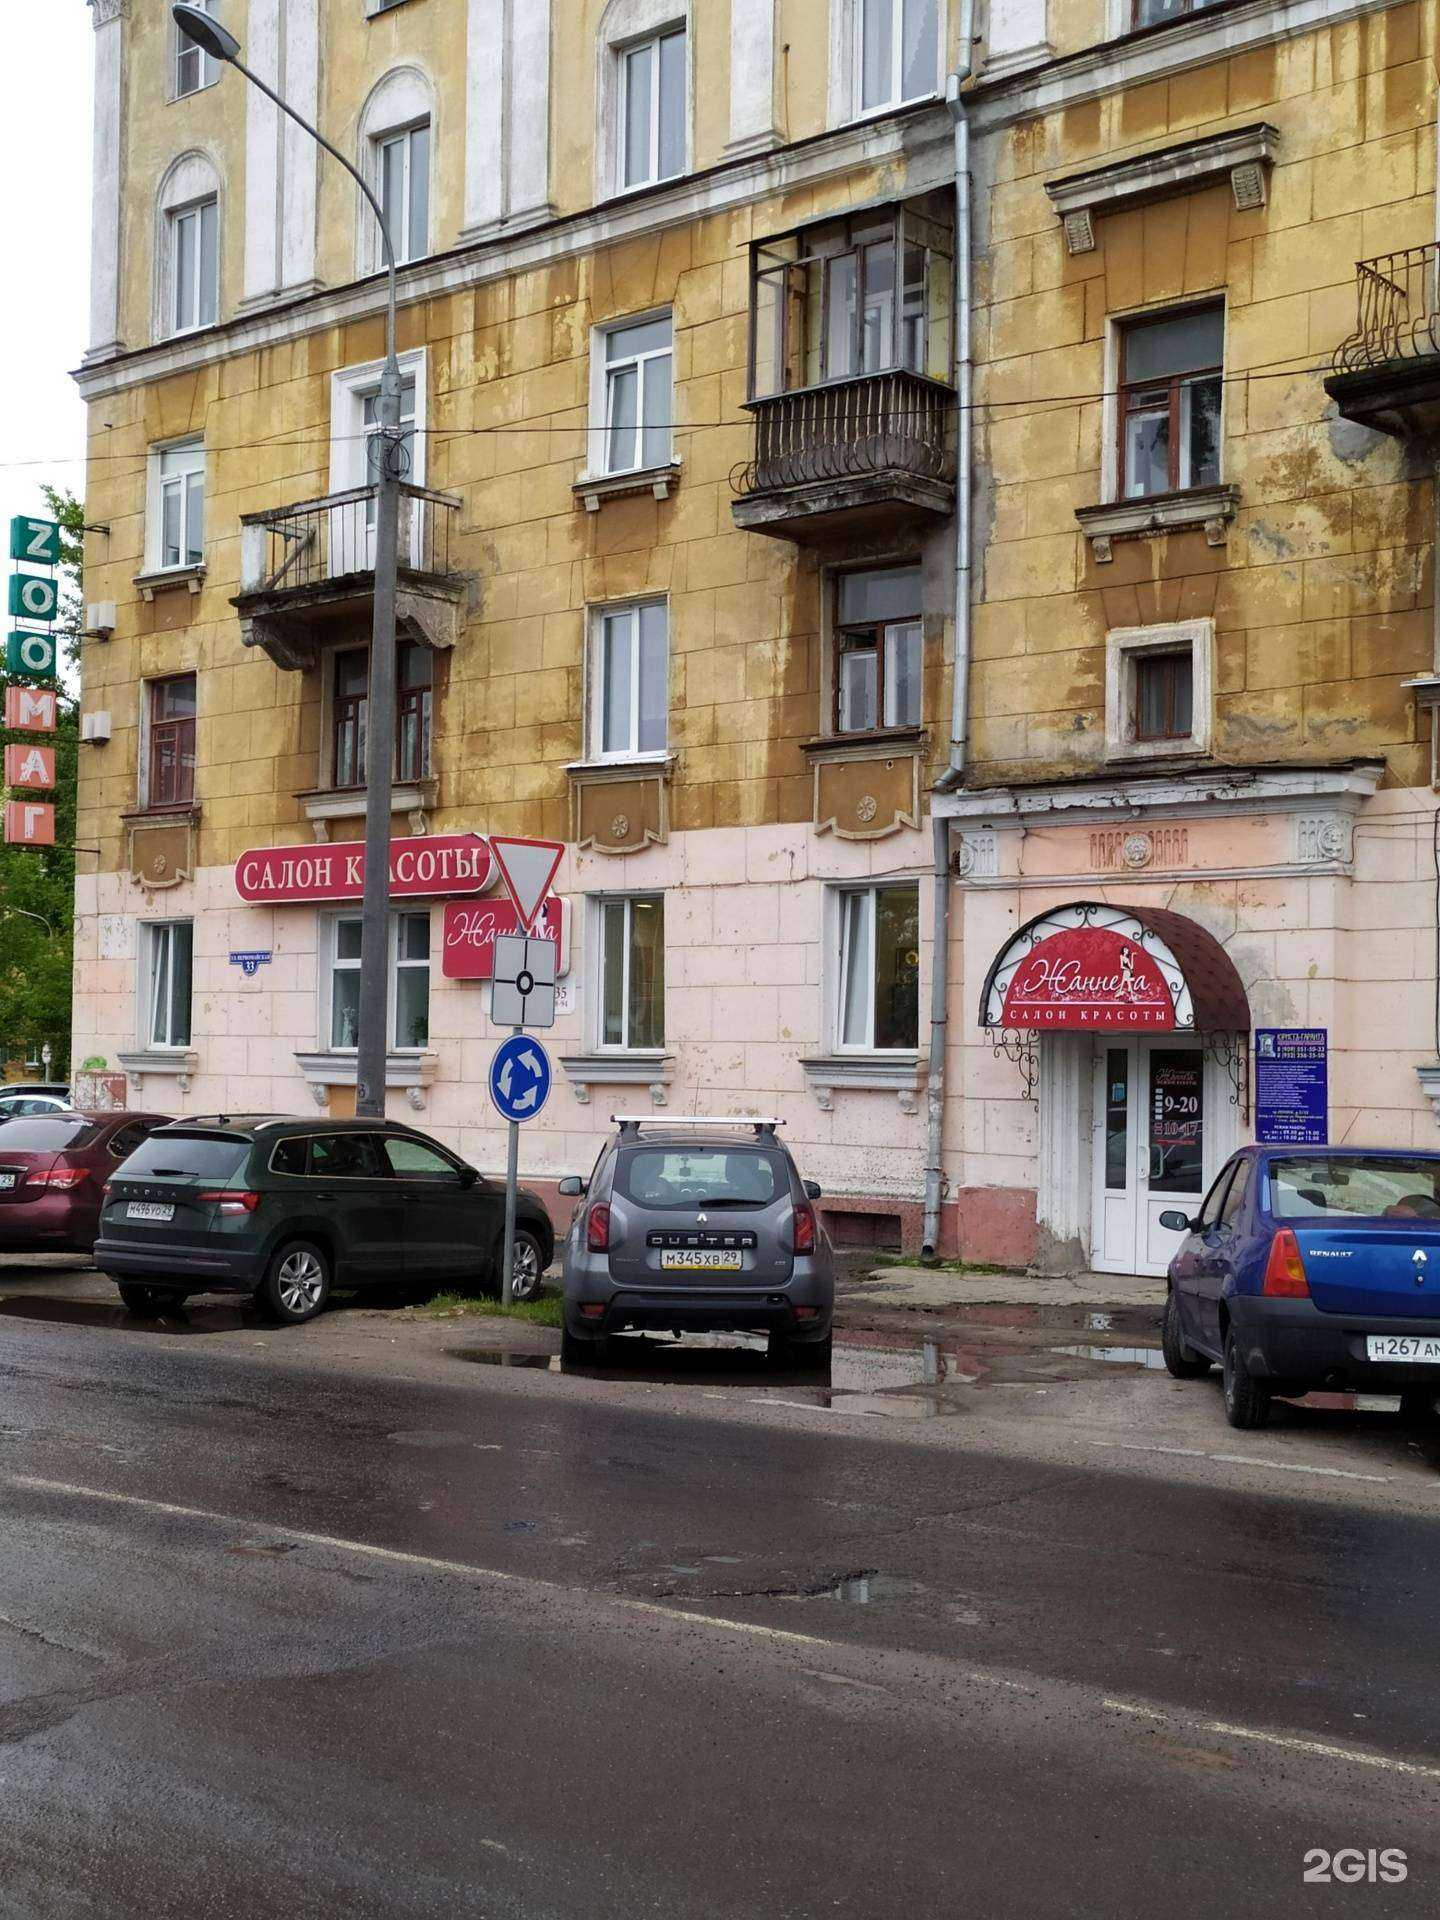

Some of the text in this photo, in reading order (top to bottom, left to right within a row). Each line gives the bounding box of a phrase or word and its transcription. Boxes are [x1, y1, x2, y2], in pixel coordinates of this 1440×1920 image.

[242, 848, 481, 890] САЛОН КСОТЫ
[245, 961, 255, 971] 33
[1010, 1010, 1165, 1021] САЛОН КРАСОТЫ
[1164, 1096, 1198, 1113] 9-20
[651, 1237, 753, 1245] DUSTER
[1309, 1249, 1354, 1258] RENAULT
